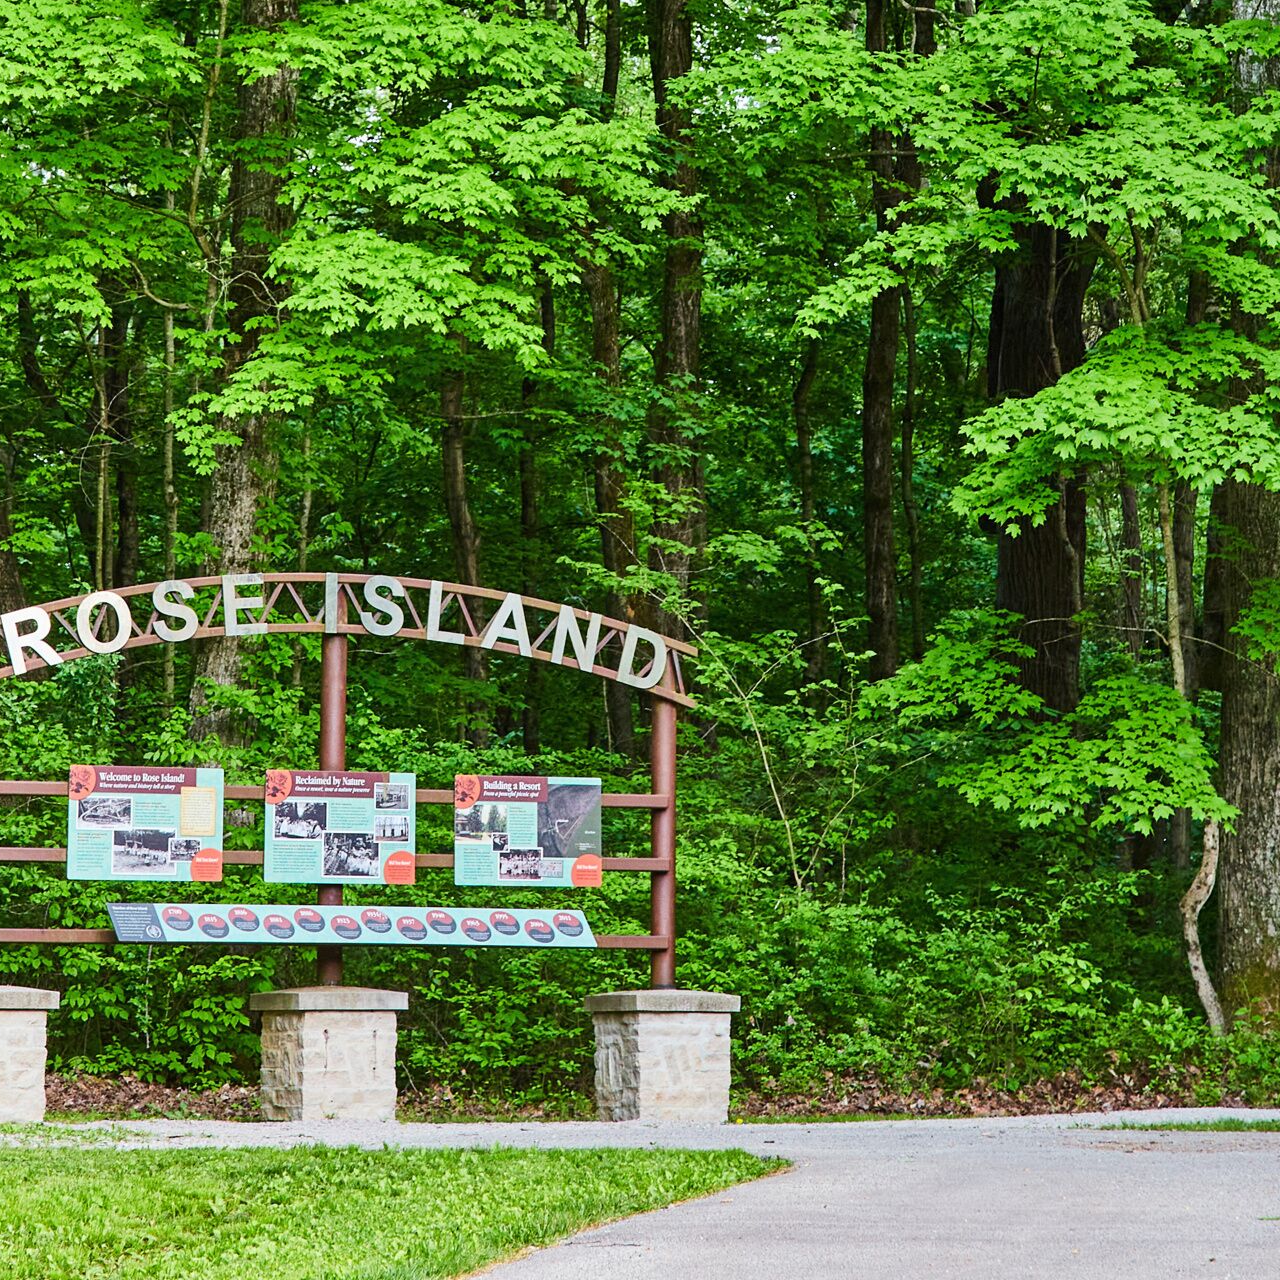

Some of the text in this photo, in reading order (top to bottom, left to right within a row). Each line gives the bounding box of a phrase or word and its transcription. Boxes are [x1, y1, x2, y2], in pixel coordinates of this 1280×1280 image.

[1, 572, 667, 689] ROSE ISLAND
[99, 772, 185, 783] Welcome to Rose Island!
[295, 775, 365, 788] Reclaimed by Nature
[483, 780, 512, 791] Building
[519, 781, 541, 791] Resort
